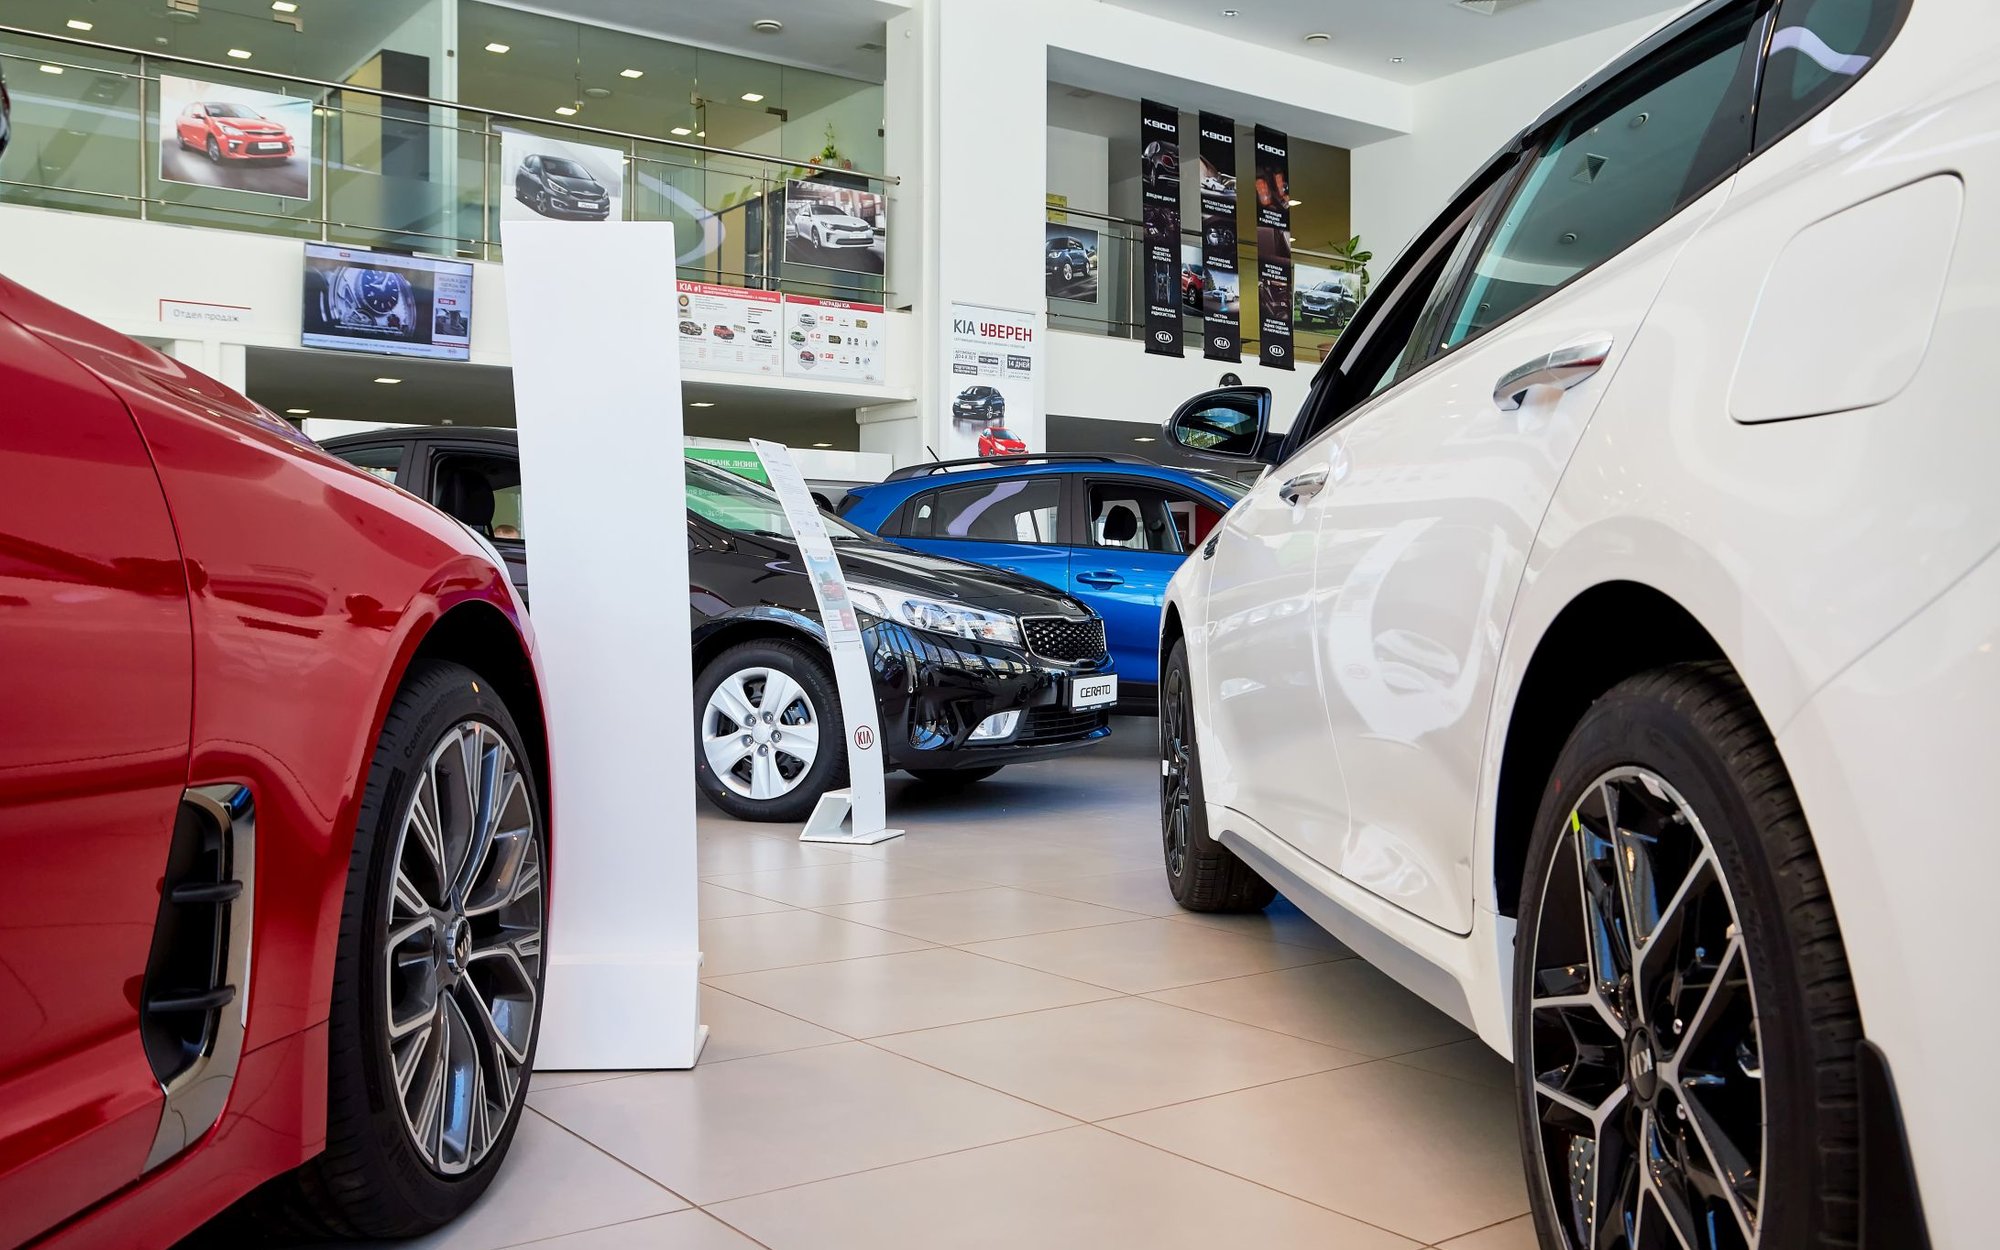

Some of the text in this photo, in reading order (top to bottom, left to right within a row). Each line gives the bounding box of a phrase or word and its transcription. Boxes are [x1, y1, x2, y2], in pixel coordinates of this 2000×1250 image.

[1144, 118, 1176, 133] K900
[1202, 129, 1232, 143] K900
[1257, 142, 1286, 157] K900
[679, 282, 692, 292] KIA
[819, 300, 841, 308] НАГРАДЫ
[173, 308, 239, 322] Отдел продаж
[954, 319, 1032, 342] KIA УВЕРЕН
[1159, 333, 1170, 341] KIA
[1216, 339, 1228, 347] KIA
[1271, 347, 1282, 355] KIA
[1080, 685, 1111, 698] CERATO
[857, 730, 872, 745] KIA
[1630, 1048, 1653, 1079] KIA
